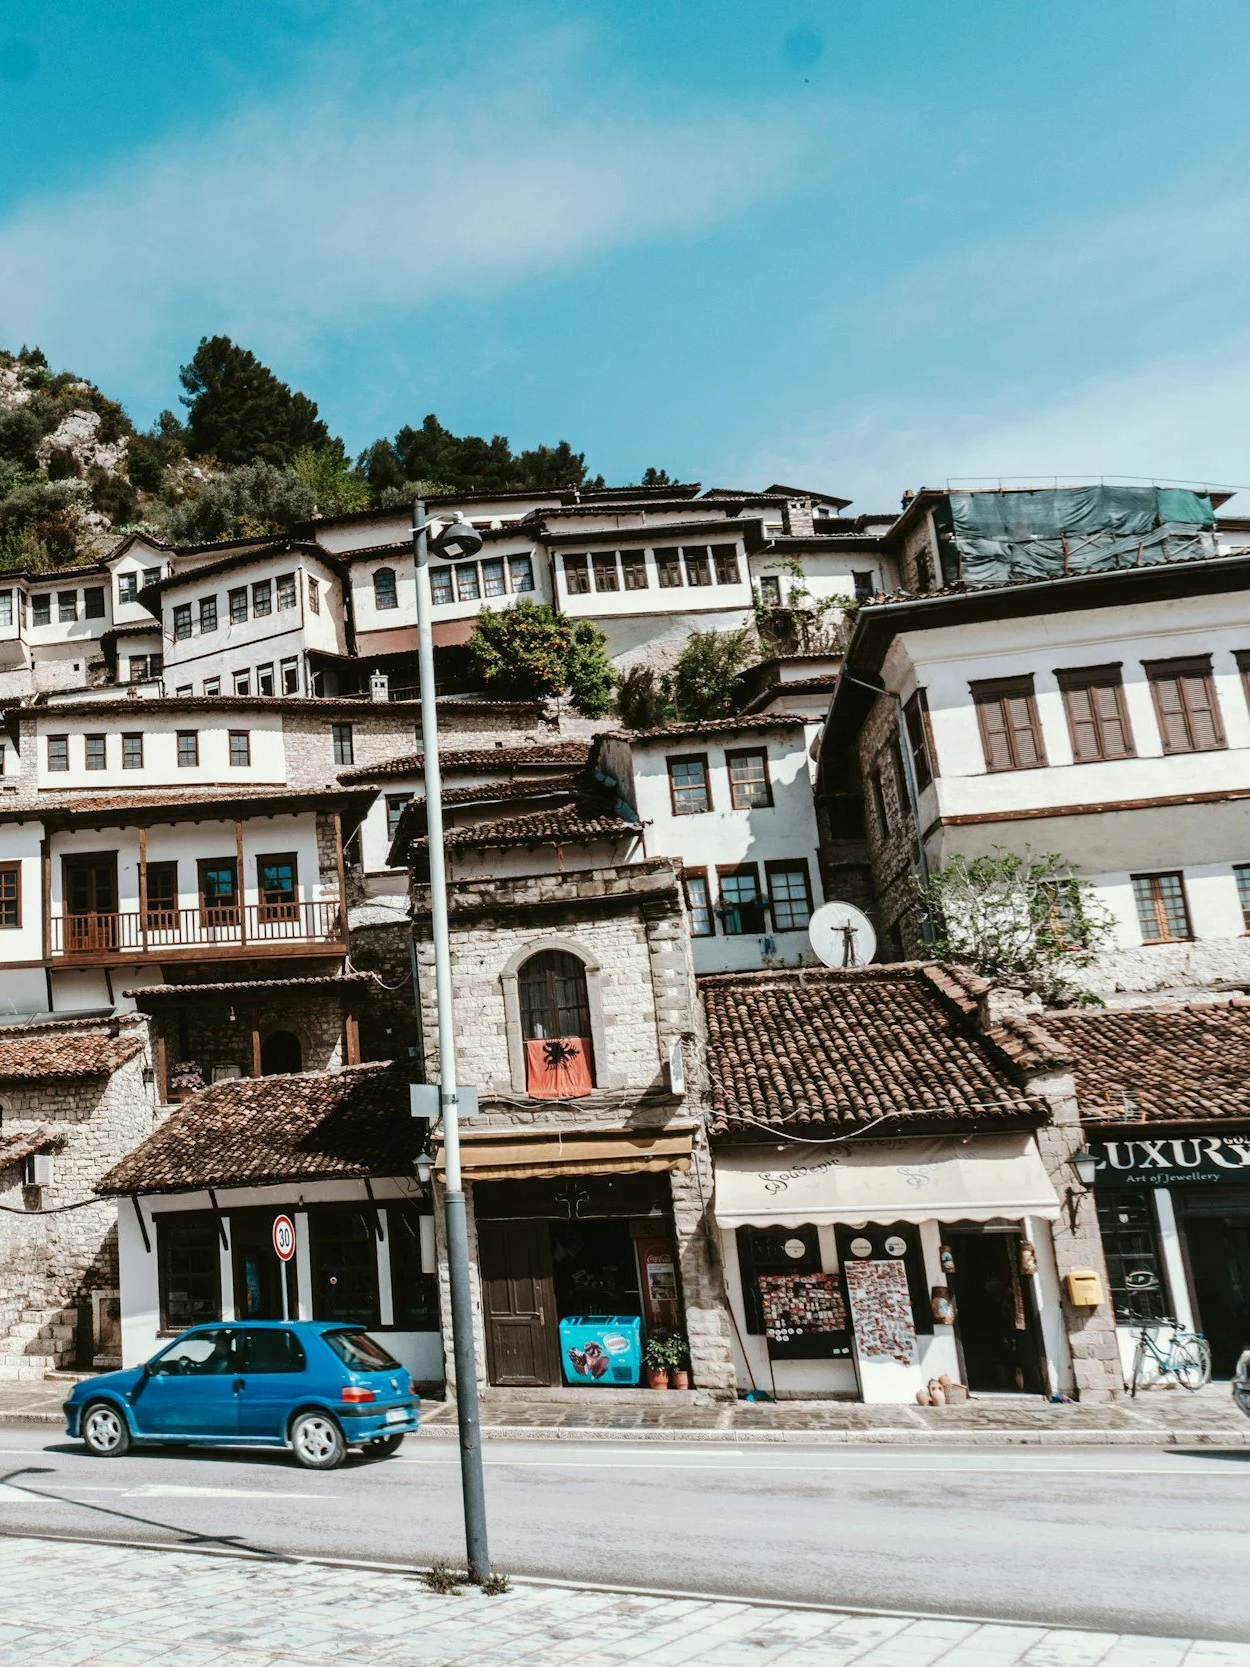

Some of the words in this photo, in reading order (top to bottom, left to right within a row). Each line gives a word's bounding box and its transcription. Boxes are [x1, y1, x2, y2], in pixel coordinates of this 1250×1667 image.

[758, 1158, 840, 1195] Souvenir
[1126, 1175, 1147, 1183] Art
[1149, 1173, 1163, 1184] of
[1162, 1171, 1219, 1183] Jewellery
[278, 1228, 290, 1247] 30
